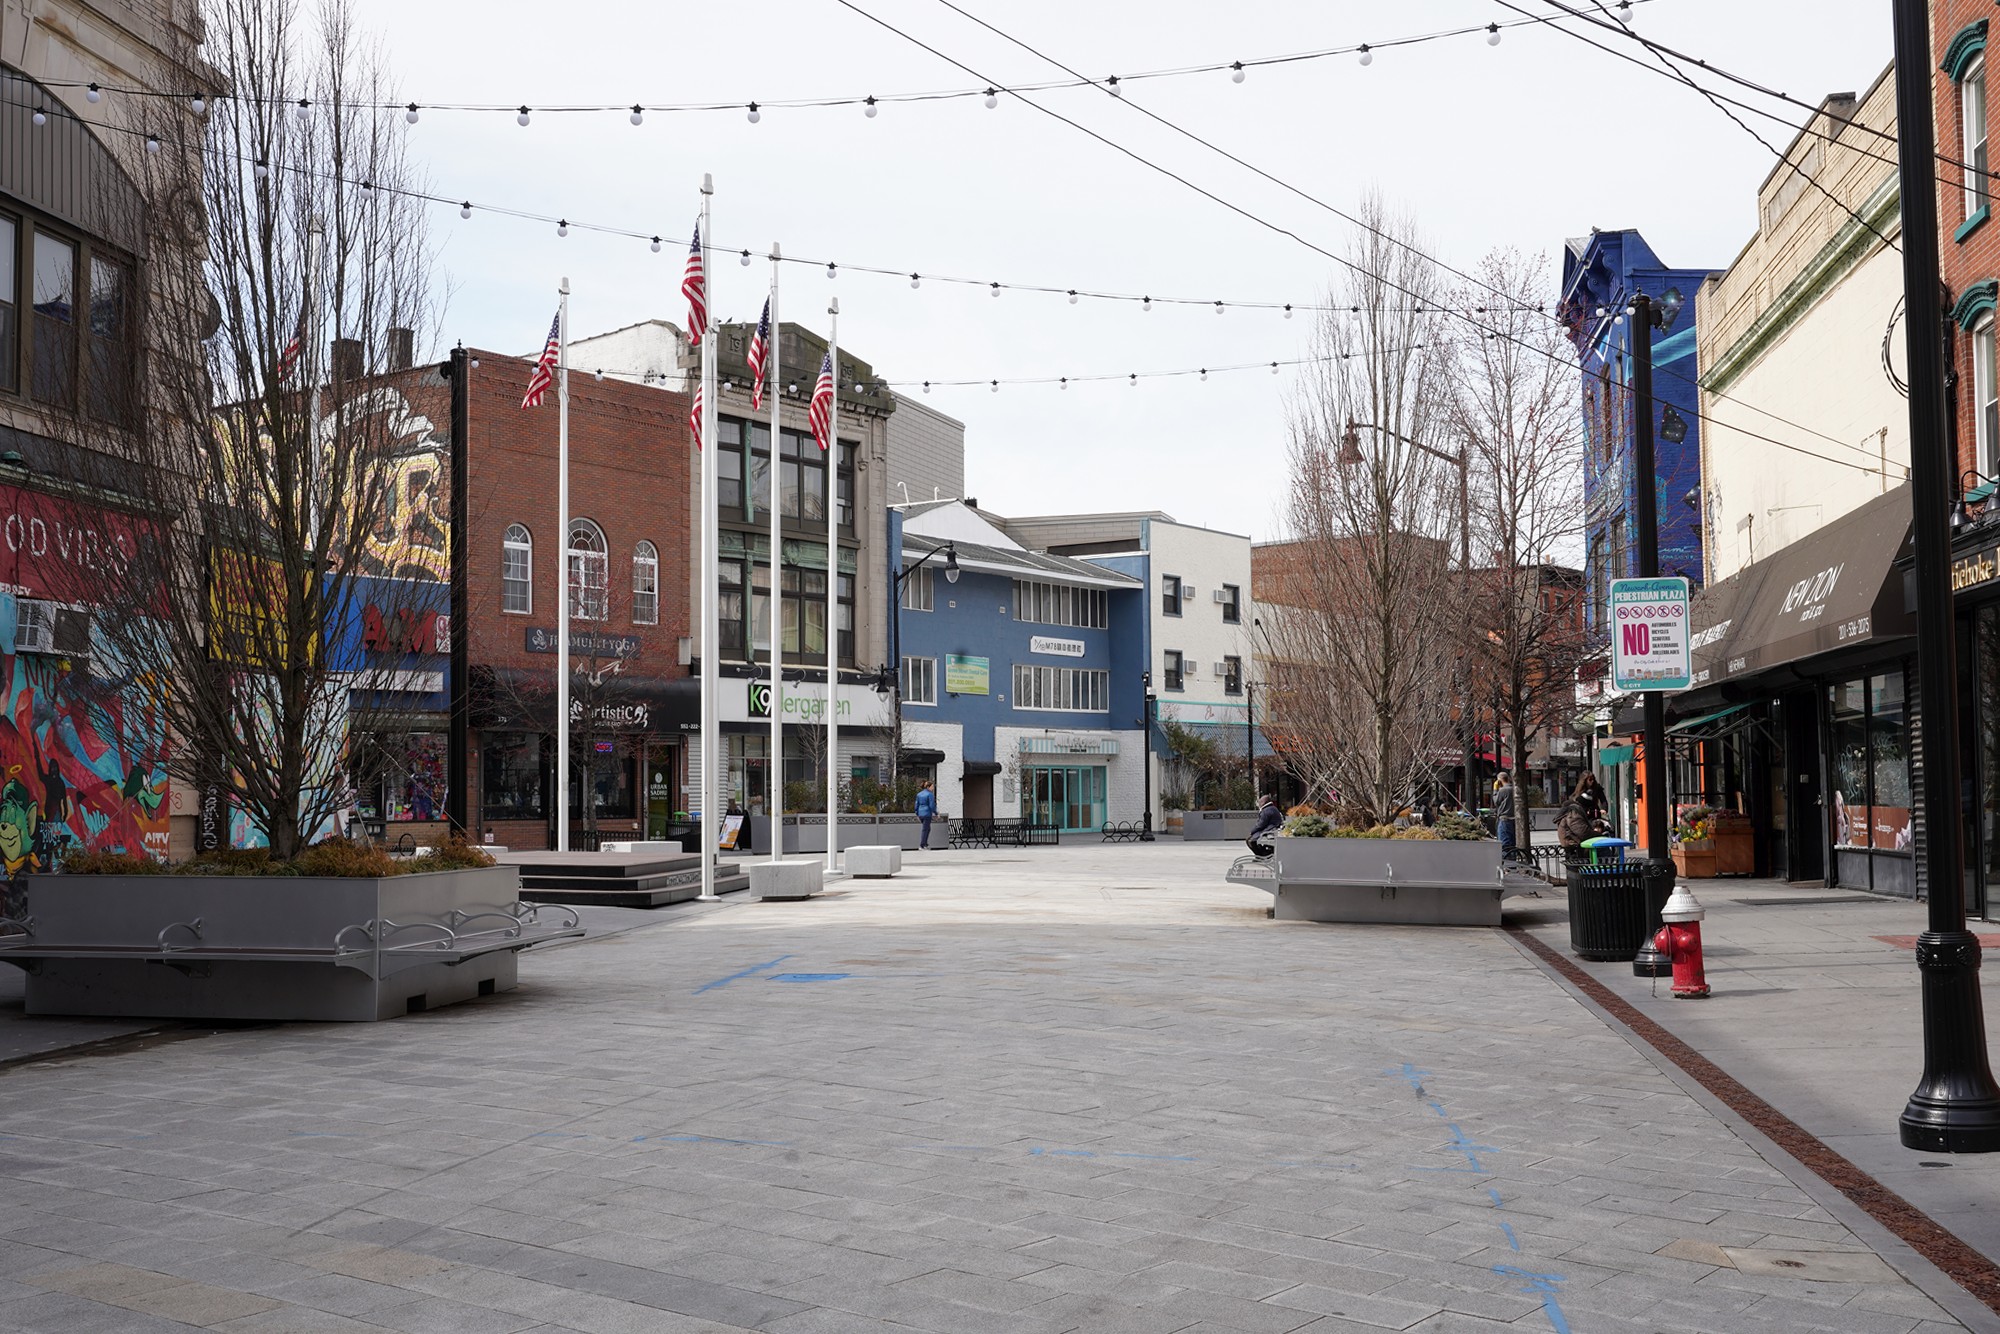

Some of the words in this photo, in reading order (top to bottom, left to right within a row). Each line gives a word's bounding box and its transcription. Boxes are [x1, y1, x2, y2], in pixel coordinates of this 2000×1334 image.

[0, 513, 47, 557] OD
[1614, 591, 1660, 602] PEDESTRIAN
[1661, 590, 1685, 601] PLAZA
[1778, 576, 1816, 616] NEW
[1804, 562, 1845, 606] ZION
[1622, 623, 1650, 656] NO
